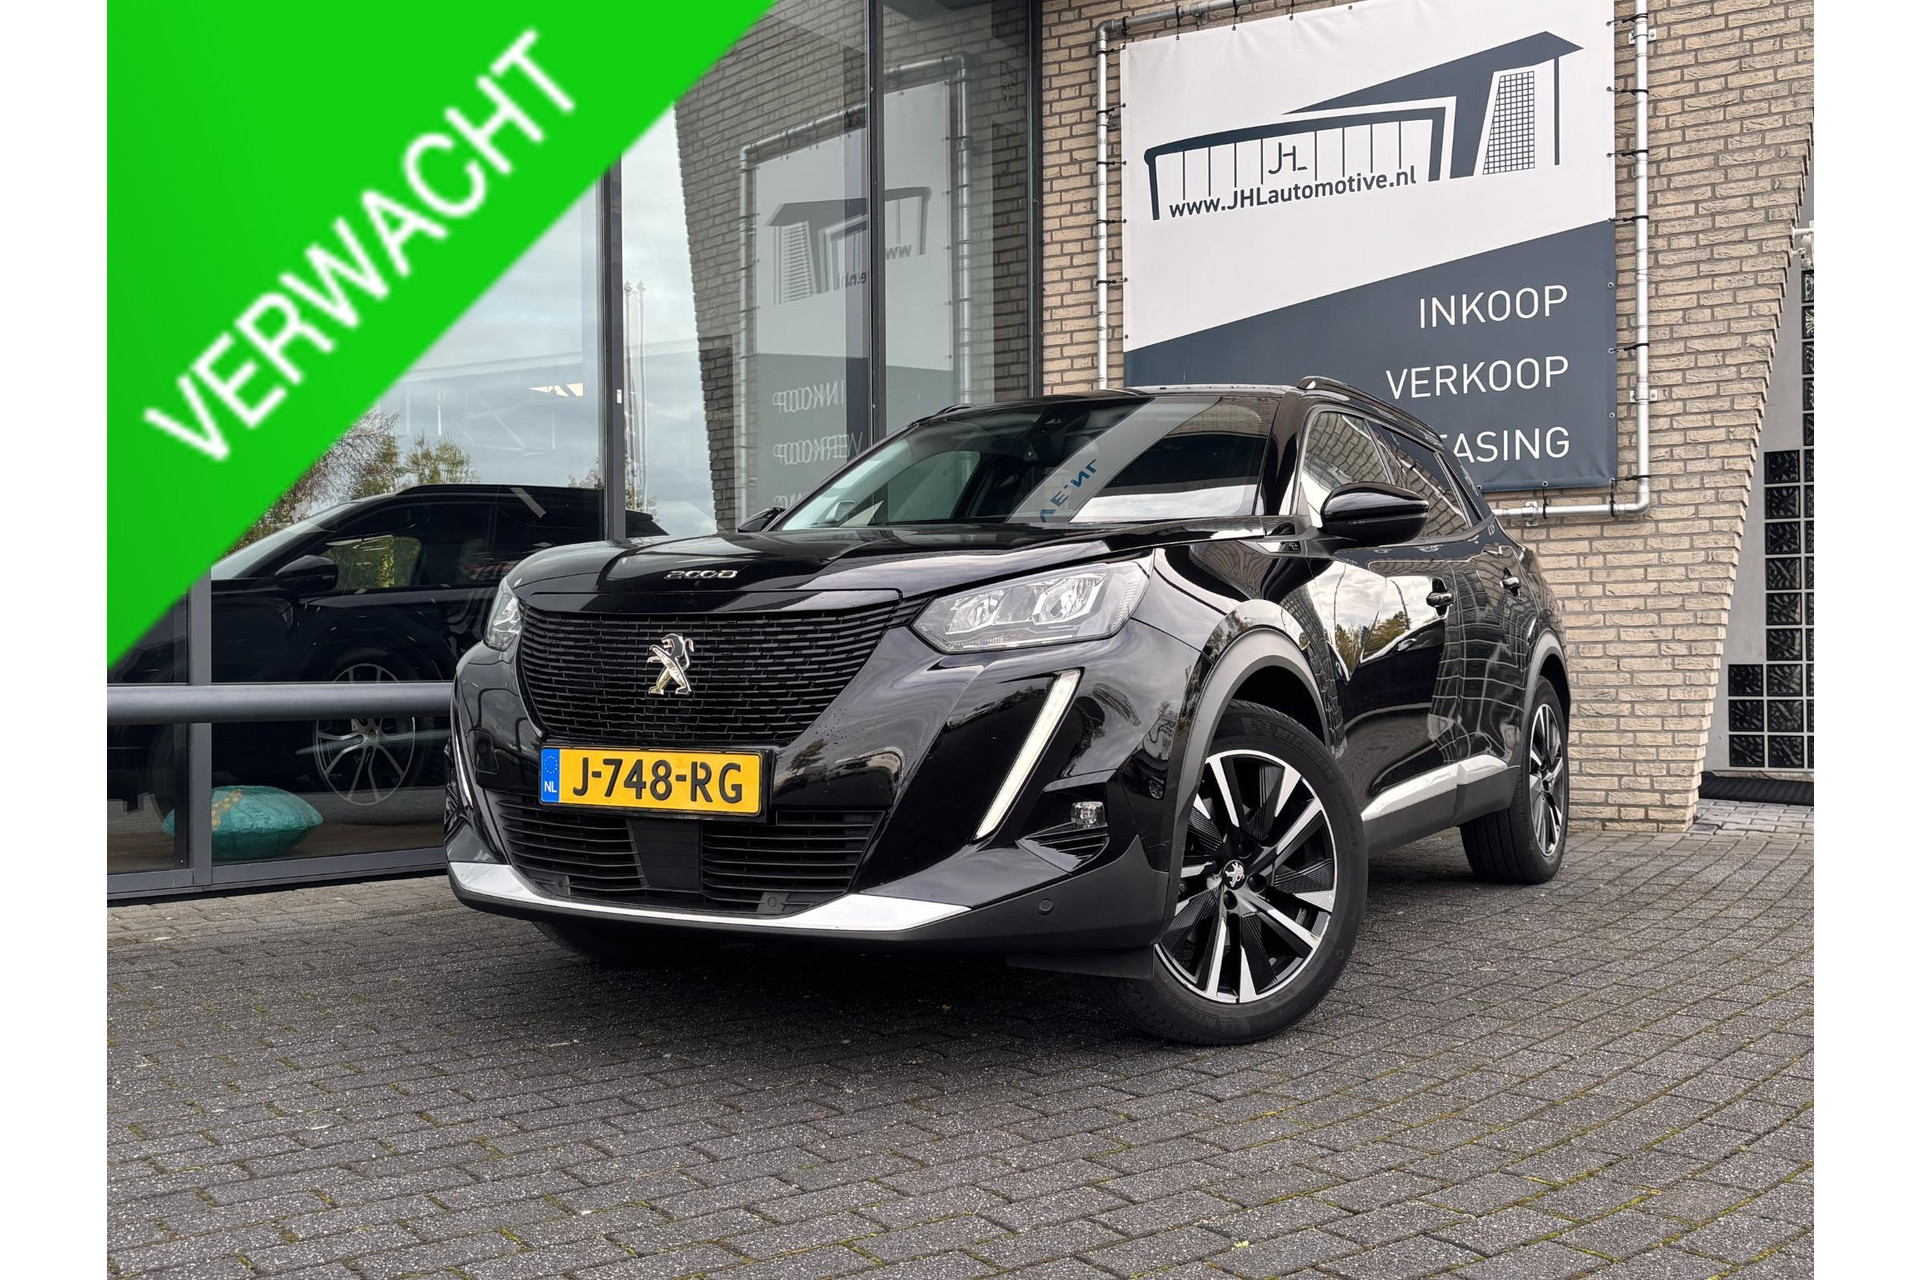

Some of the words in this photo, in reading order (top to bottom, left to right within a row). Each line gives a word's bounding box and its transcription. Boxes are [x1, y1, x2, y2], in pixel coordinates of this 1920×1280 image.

[1169, 165, 1417, 218] www.JHLautomotive.nl
[1419, 284, 1568, 329] INKOOP
[1385, 355, 1569, 400] VERKOOP
[1440, 426, 1570, 463] ASING
[544, 780, 558, 793] NL
[572, 756, 743, 804] J-748-RG
